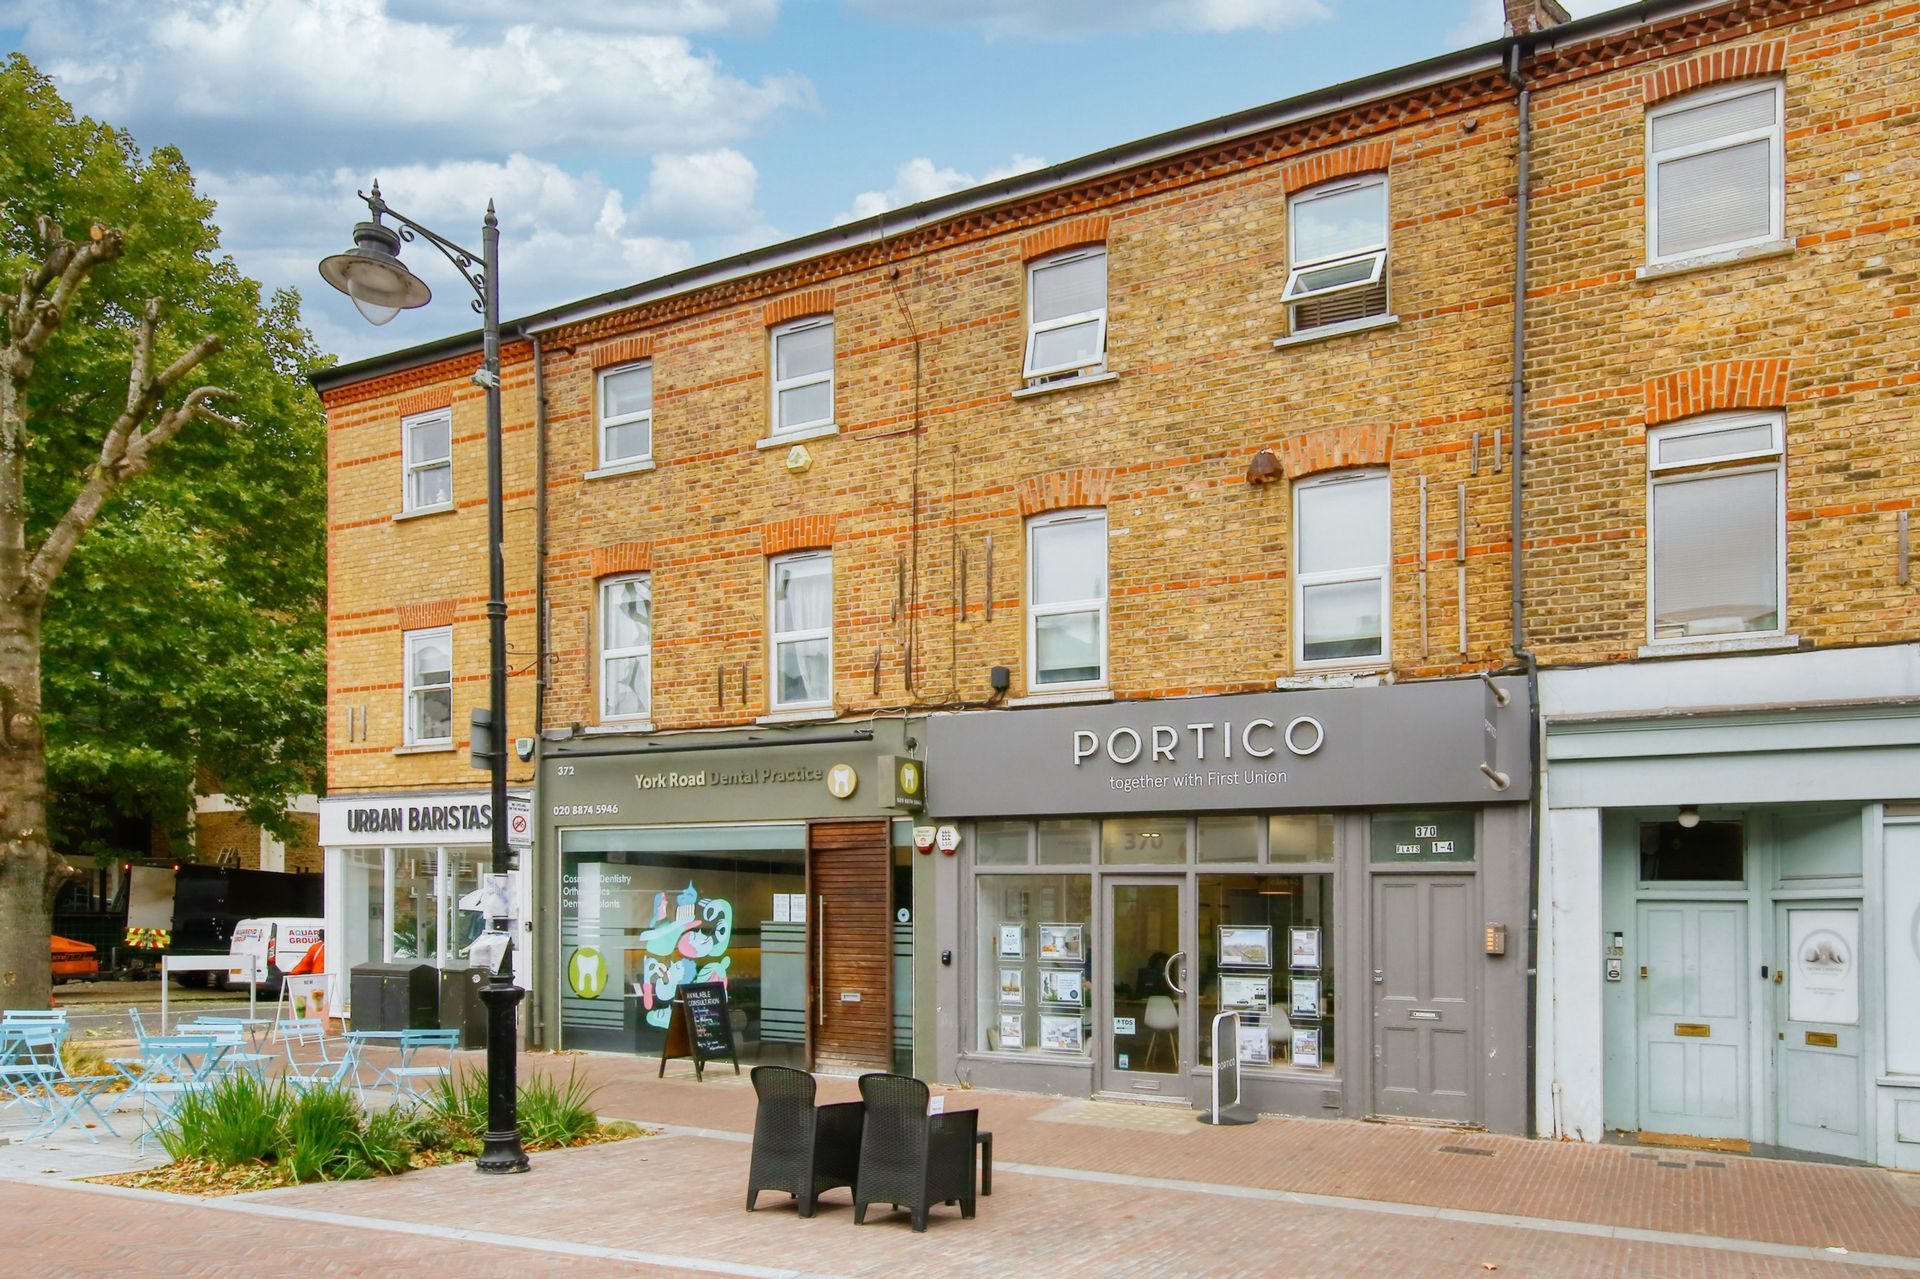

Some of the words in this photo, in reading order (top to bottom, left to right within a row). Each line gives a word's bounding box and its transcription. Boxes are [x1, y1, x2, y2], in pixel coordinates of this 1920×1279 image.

[1073, 716, 1325, 766] PORTICO
[557, 766, 575, 776] 372
[634, 773, 667, 789] York
[669, 771, 706, 788] Road
[709, 770, 759, 786] Dental
[761, 766, 823, 782] Practice
[1109, 775, 1169, 793] together
[1173, 772, 1203, 787] with
[1208, 771, 1239, 786] First
[1244, 770, 1287, 785] Union
[553, 806, 571, 816] 020
[572, 805, 593, 815] 8874
[595, 804, 618, 814] 5946
[347, 807, 402, 832] URBAN
[408, 804, 493, 831] BARISTAS
[1416, 826, 1436, 837] 370
[1123, 832, 1164, 850] 370
[1397, 845, 1420, 853] FLATS
[1434, 842, 1453, 852] 1-4
[600, 874, 632, 885] Dentistry
